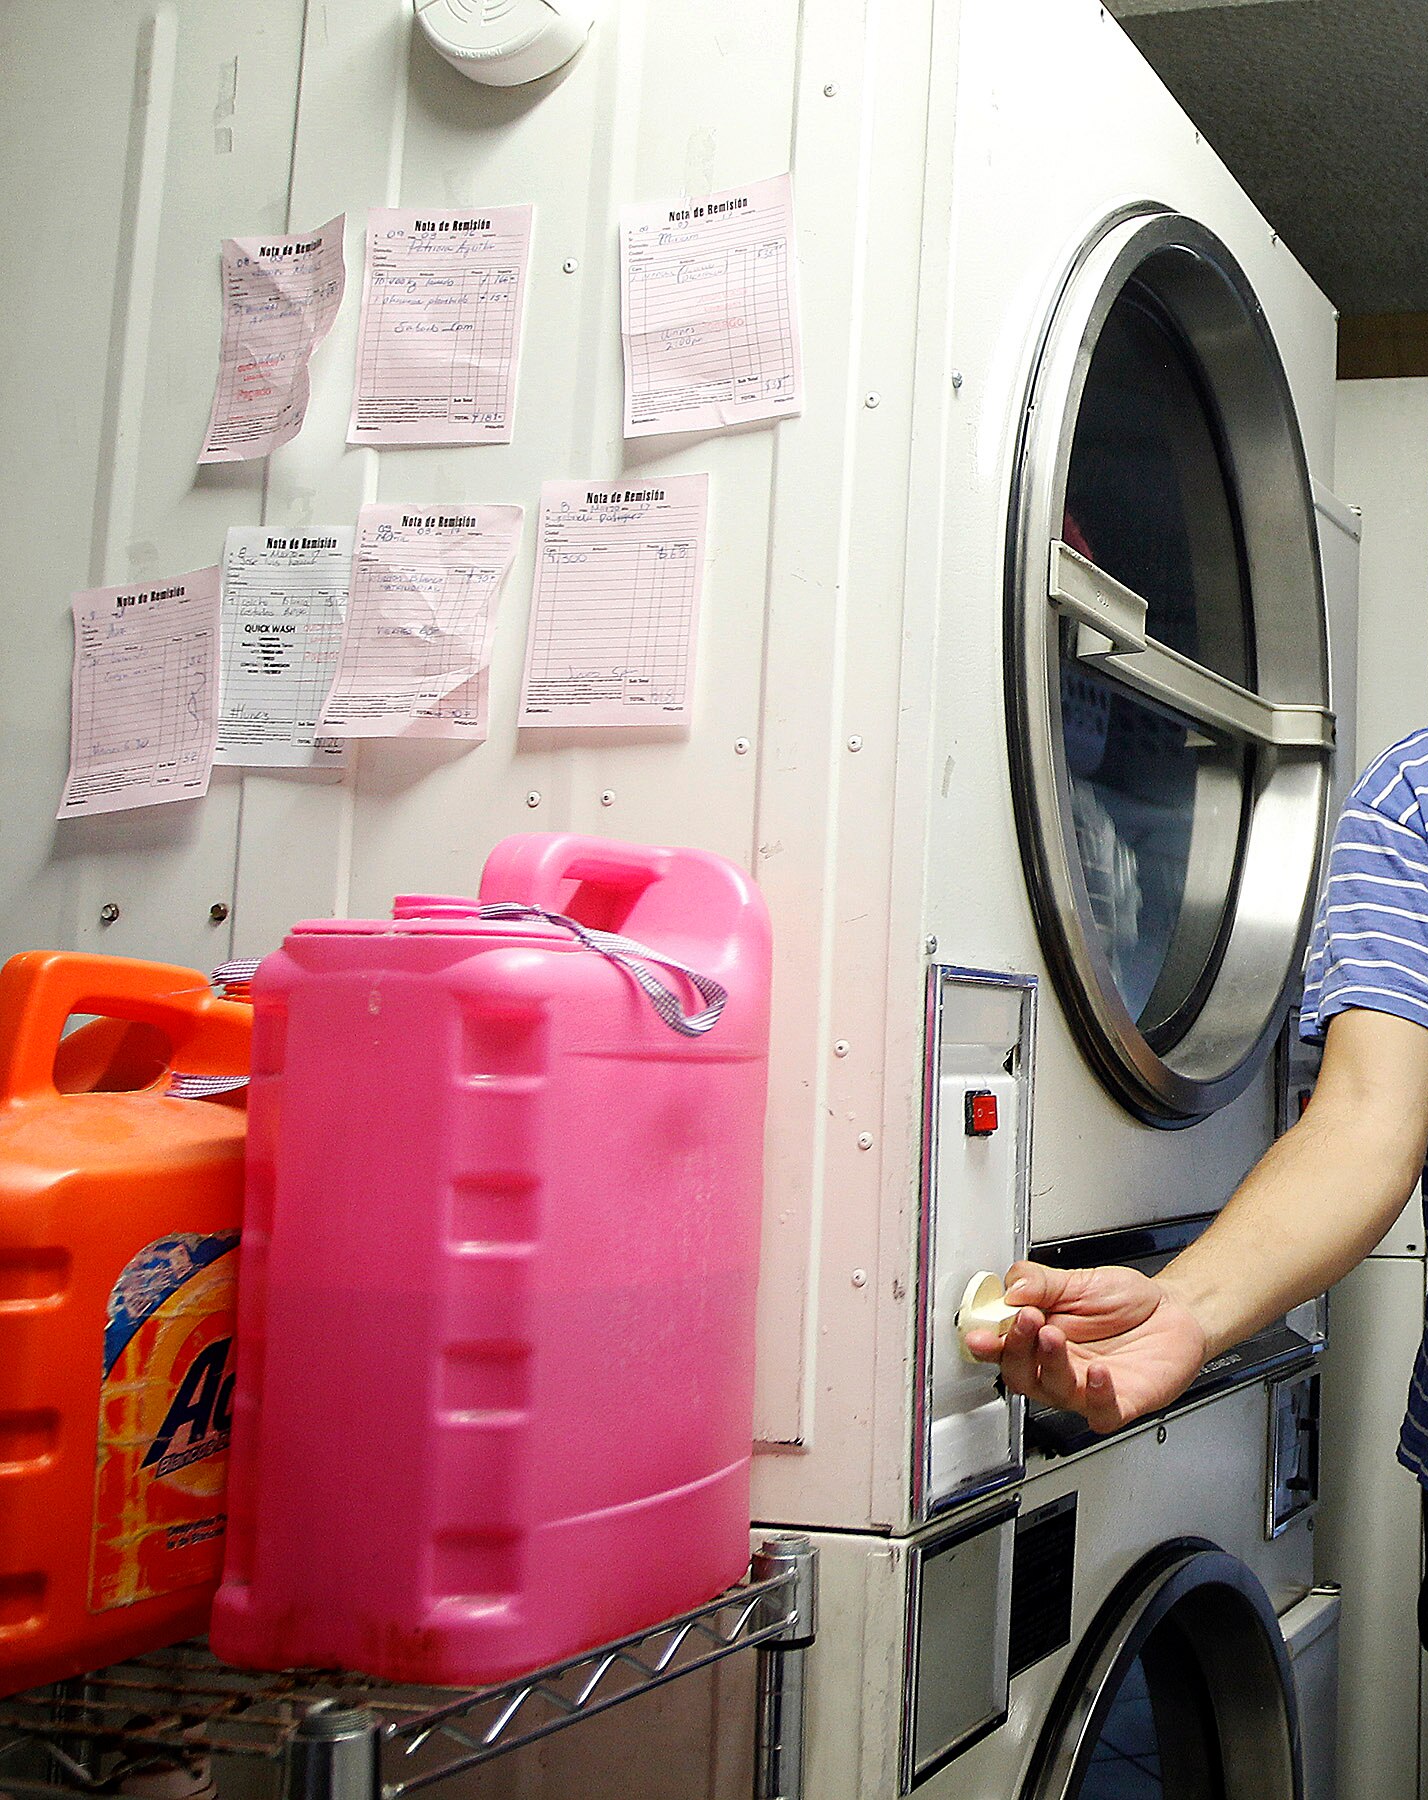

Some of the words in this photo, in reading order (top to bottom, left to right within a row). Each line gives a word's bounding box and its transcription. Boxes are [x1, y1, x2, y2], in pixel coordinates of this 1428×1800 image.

[669, 211, 690, 222] Nota
[694, 207, 704, 218] de
[707, 197, 748, 215] Remisión
[415, 220, 436, 232] Nota
[439, 220, 449, 231] de
[452, 219, 491, 231] Remisión
[259, 246, 280, 257] Nota
[282, 244, 292, 256] de
[586, 492, 608, 504] Nota
[610, 491, 621, 503] de
[624, 489, 665, 503] Remisión
[401, 515, 422, 527] Nota
[424, 515, 436, 528] de
[438, 515, 476, 528] Remisión
[266, 538, 286, 549] Nota
[289, 538, 299, 549] de
[301, 537, 337, 549] Remisión
[116, 596, 135, 608] Nota
[138, 593, 148, 604] de
[150, 586, 185, 603] Remisión
[244, 624, 271, 634] QUICK
[272, 625, 296, 634] WASH
[140, 1337, 235, 1469] Ac
